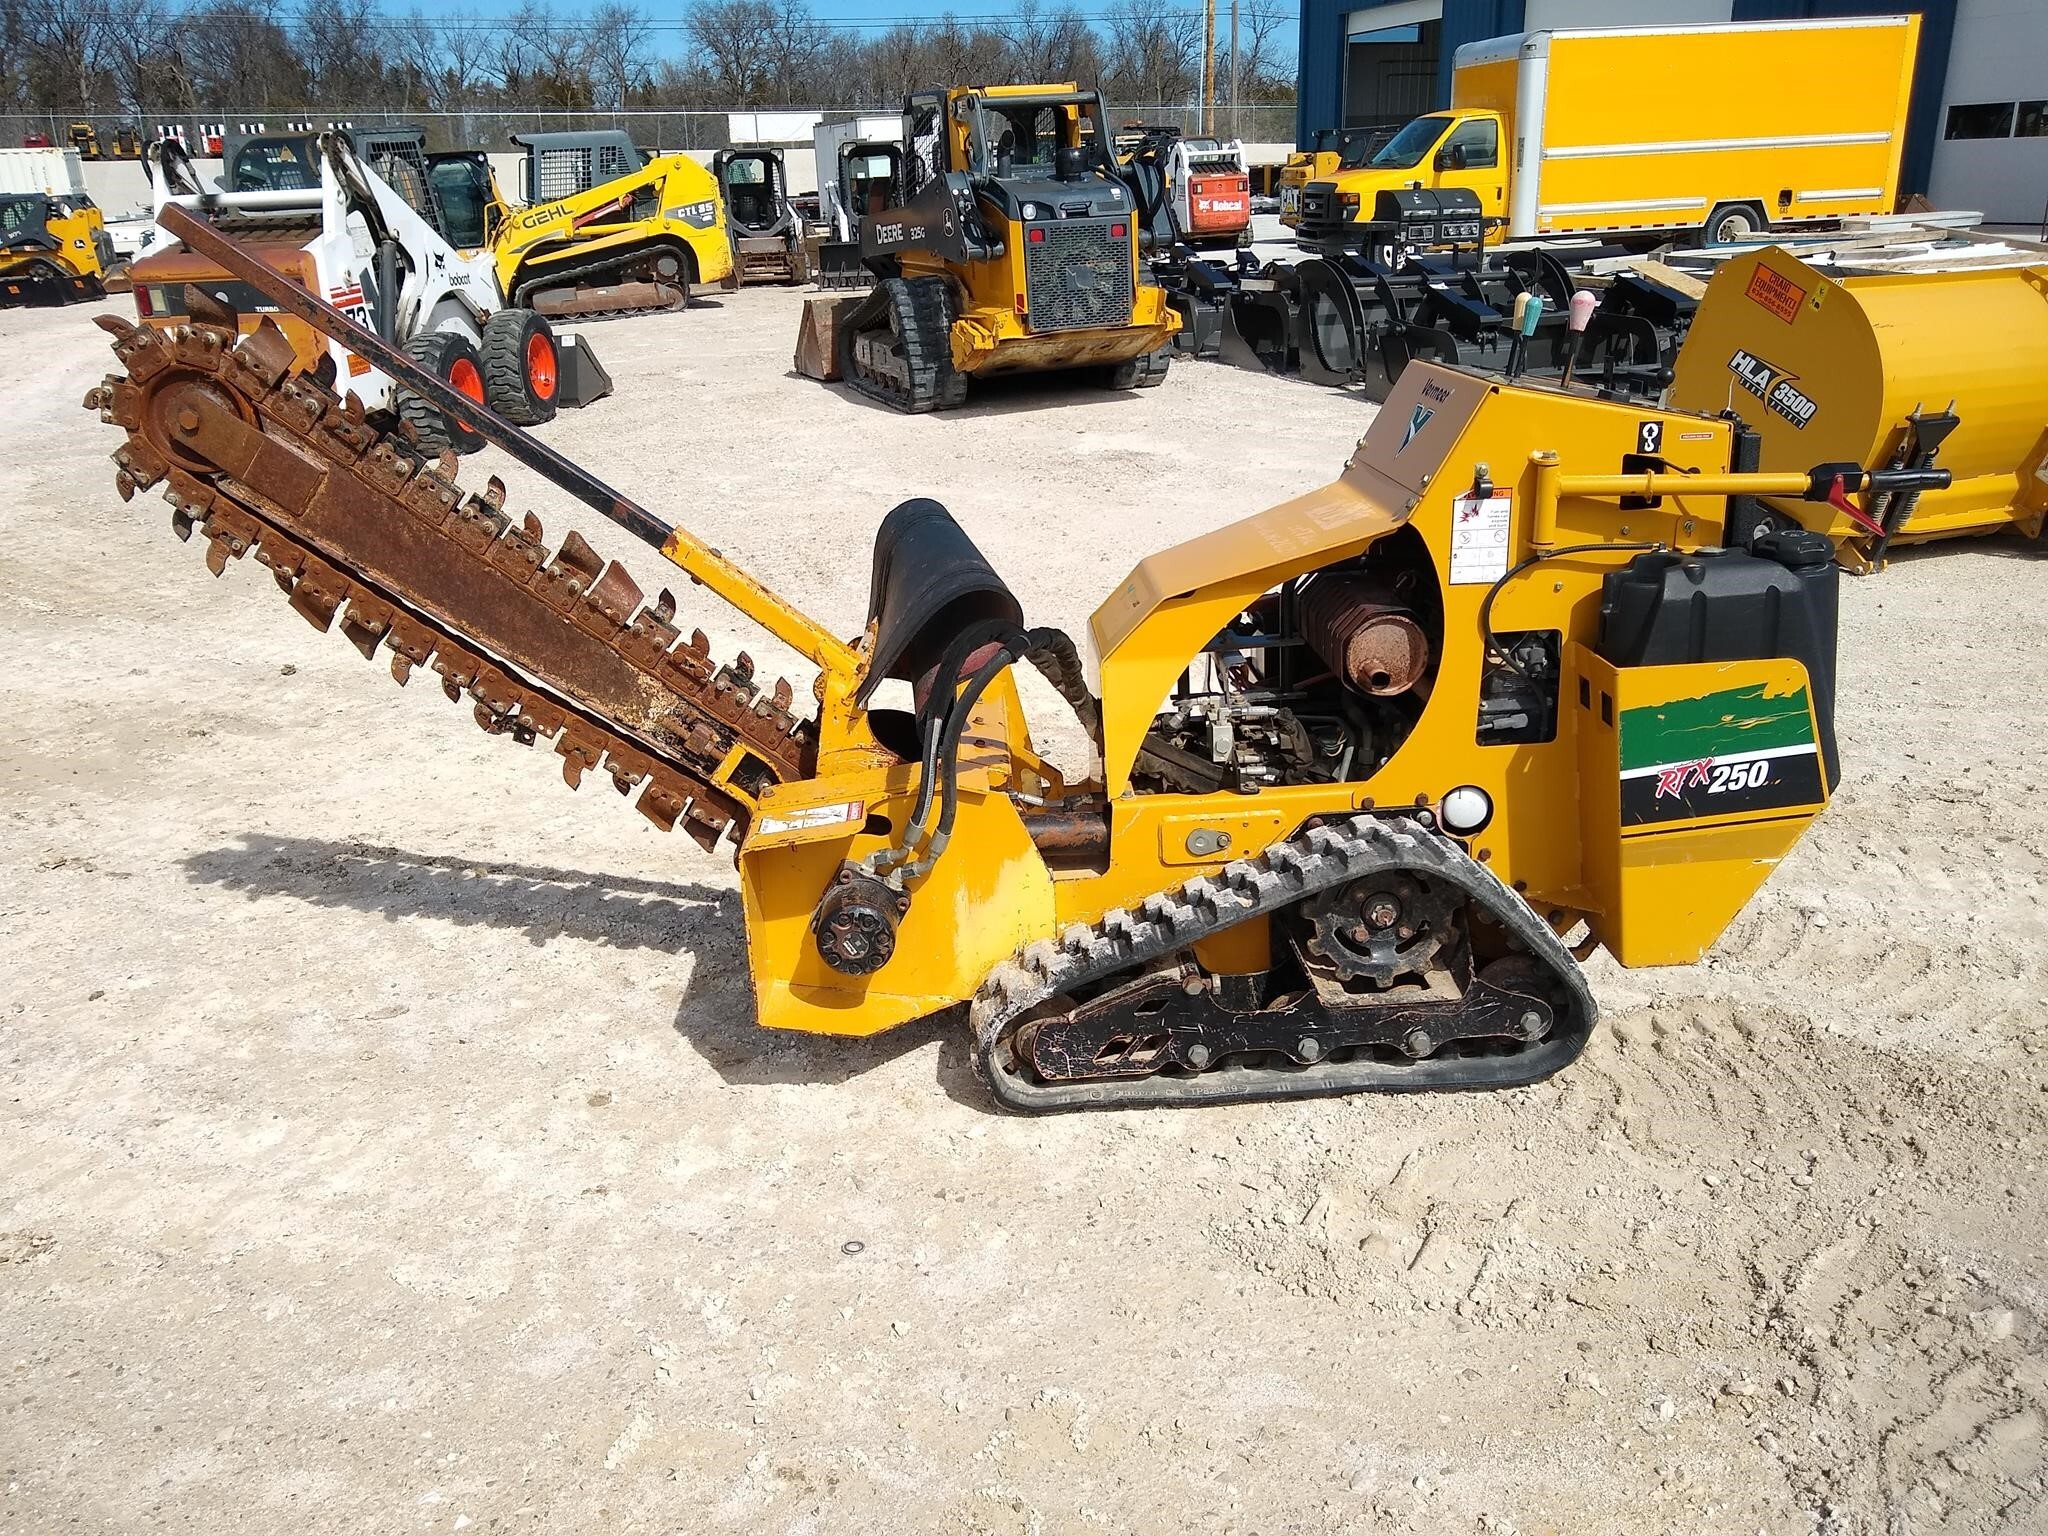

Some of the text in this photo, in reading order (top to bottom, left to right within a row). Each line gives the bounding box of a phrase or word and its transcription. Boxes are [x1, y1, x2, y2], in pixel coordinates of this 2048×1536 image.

[1212, 200, 1243, 212] Bobcat
[1281, 188, 1300, 213] CAT
[522, 204, 574, 229] GEHL
[876, 223, 926, 245] DEERE 325G
[448, 272, 471, 287] bobcat
[1768, 273, 1791, 293] CRAIG
[1421, 377, 1450, 403] Vermeer
[1730, 350, 1816, 419] HLA 3500
[1655, 757, 1769, 799] RTX 250
